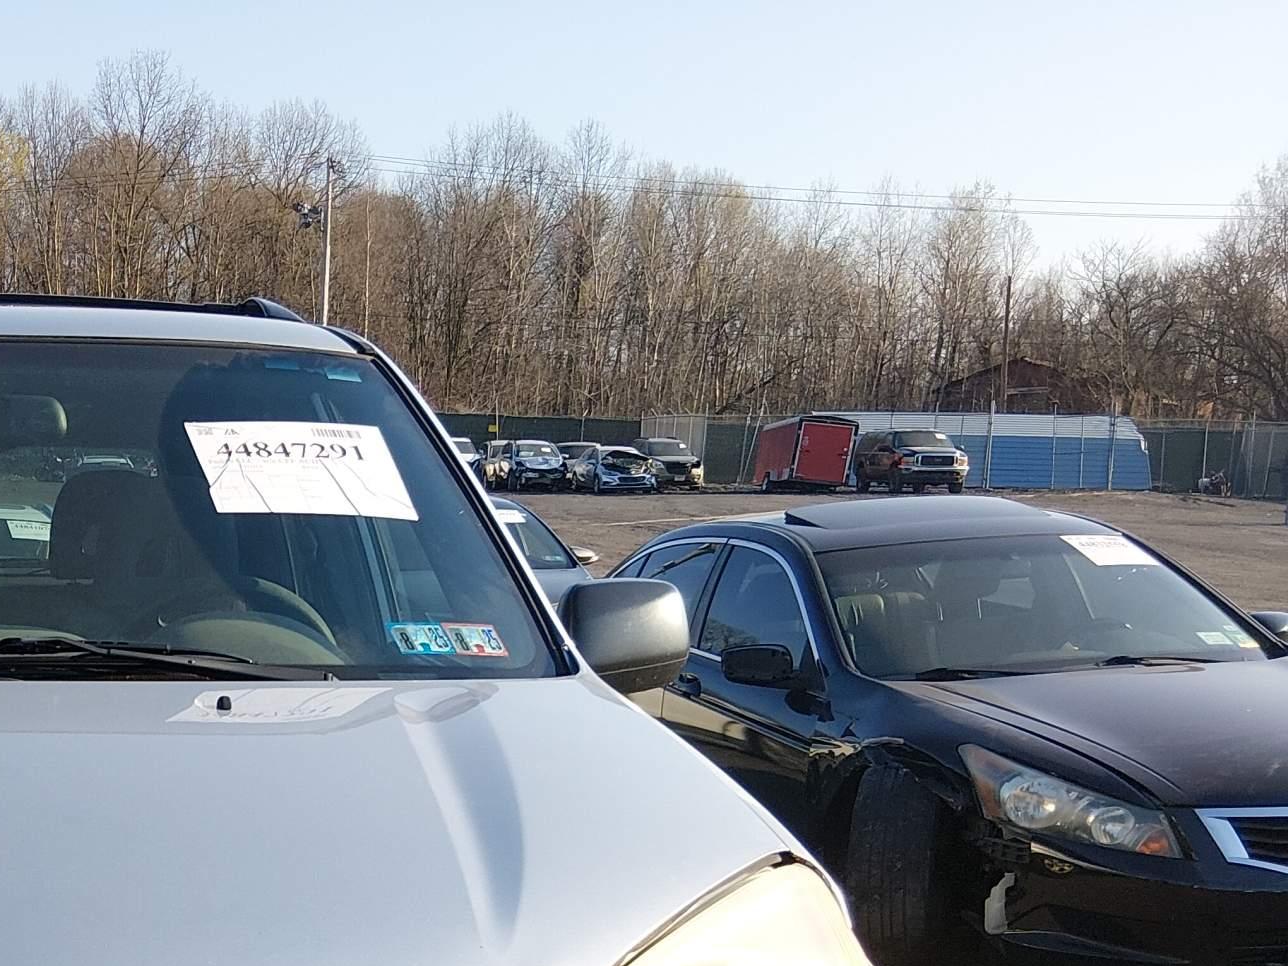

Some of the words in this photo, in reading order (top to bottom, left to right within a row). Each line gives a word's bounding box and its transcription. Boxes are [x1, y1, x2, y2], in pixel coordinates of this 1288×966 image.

[216, 441, 364, 461] 44847291
[428, 627, 449, 649] 25
[482, 629, 502, 650] 25
